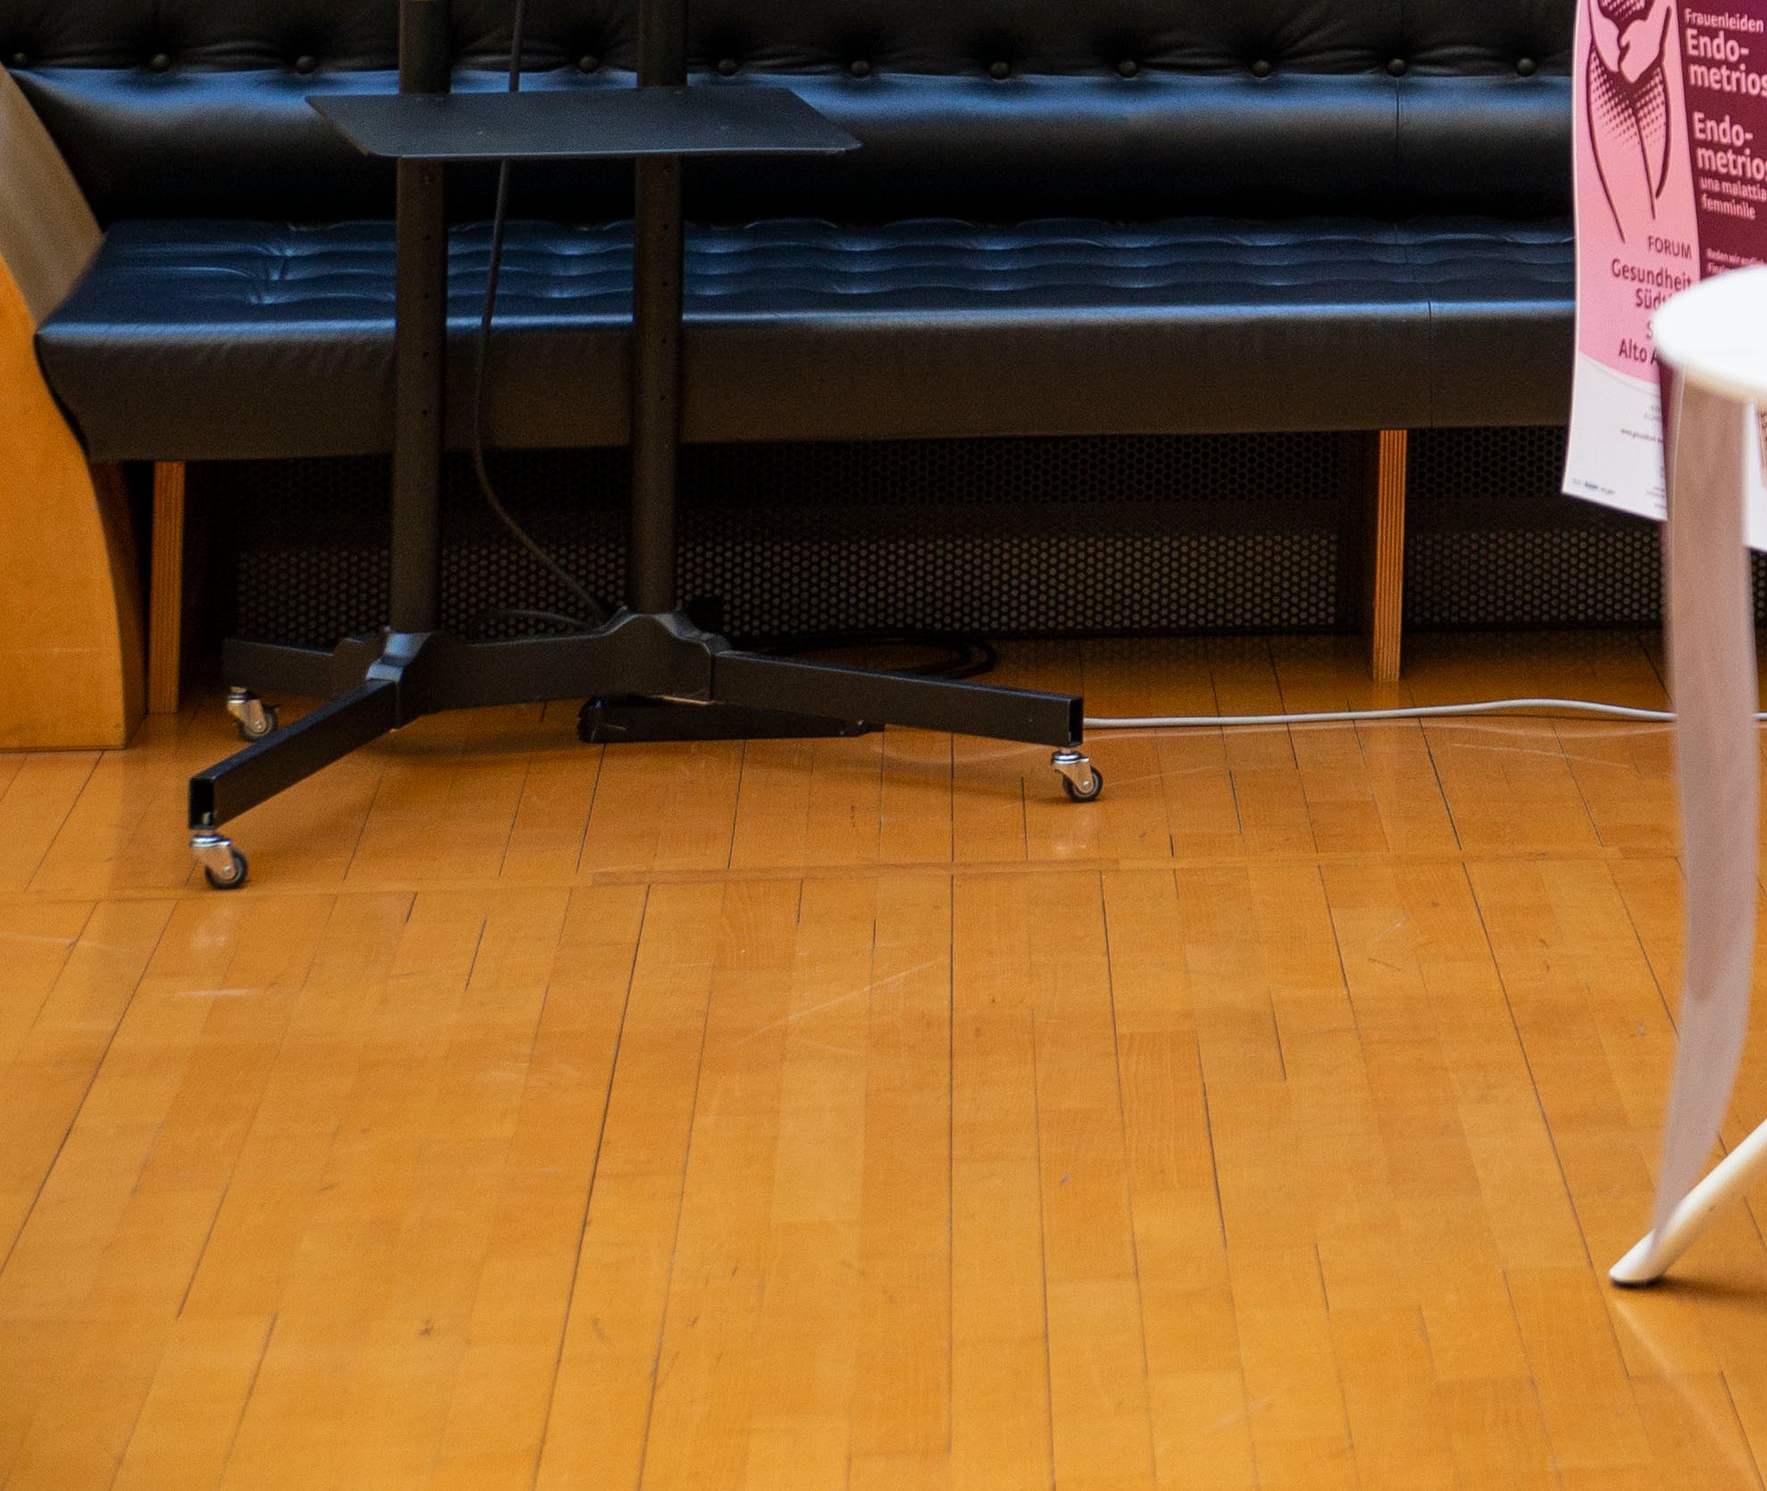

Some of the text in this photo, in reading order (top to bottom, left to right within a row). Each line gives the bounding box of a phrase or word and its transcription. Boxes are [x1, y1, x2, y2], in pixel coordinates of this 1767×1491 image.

[1684, 8, 1764, 33] Frauenleiden
[1686, 28, 1750, 62] Endo-
[1693, 111, 1754, 147] Endo-
[1700, 177, 1767, 203] una malattia
[1702, 194, 1756, 220] femminile
[1648, 235, 1692, 260] FORUM
[1619, 338, 1648, 363] Alto
